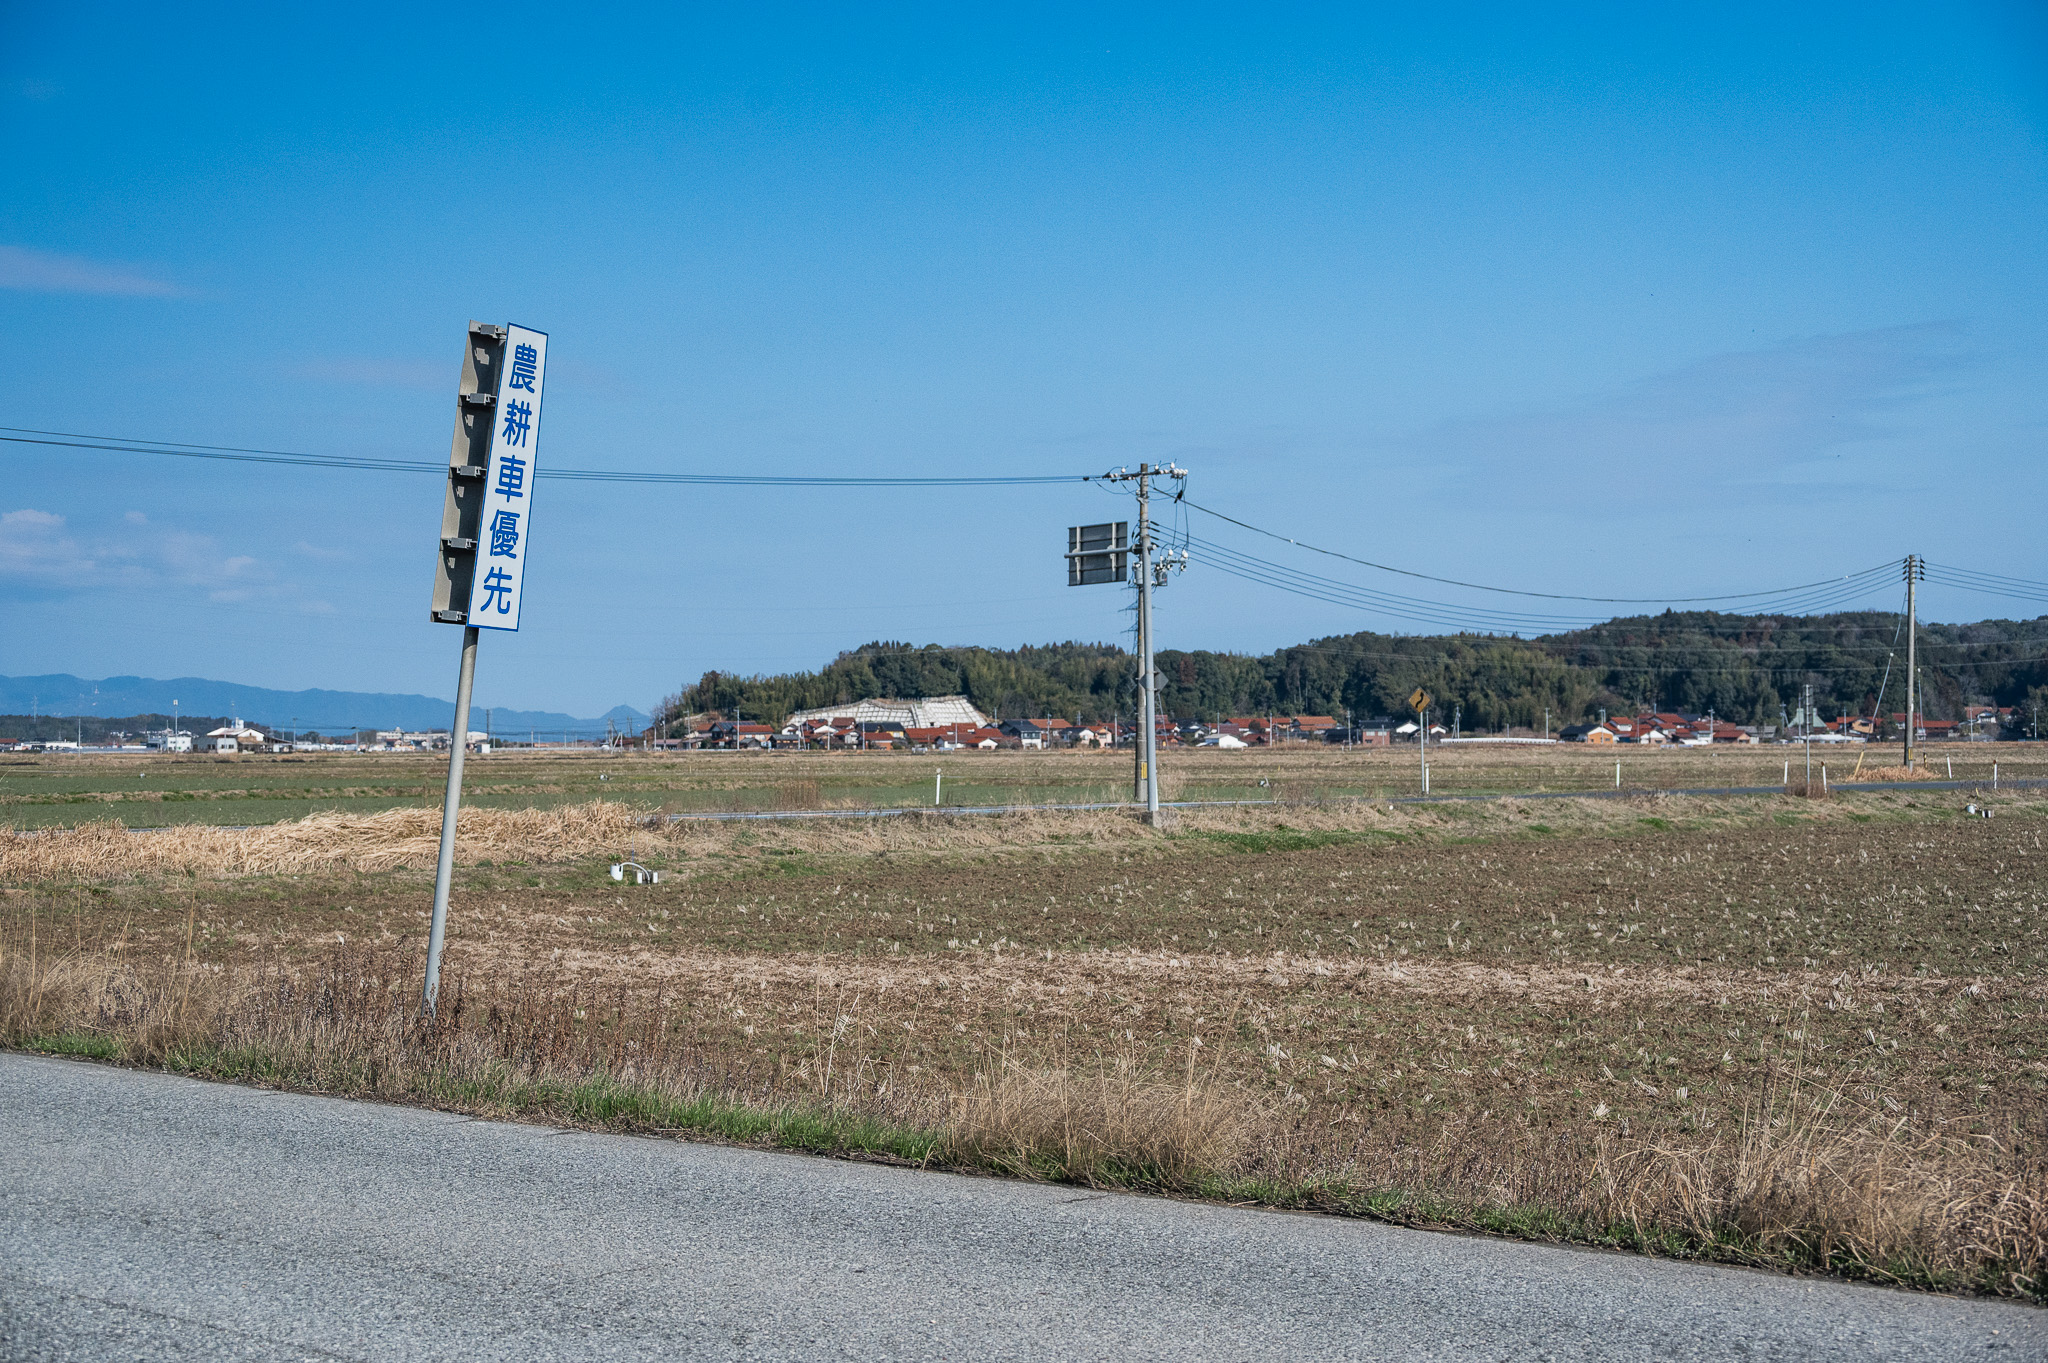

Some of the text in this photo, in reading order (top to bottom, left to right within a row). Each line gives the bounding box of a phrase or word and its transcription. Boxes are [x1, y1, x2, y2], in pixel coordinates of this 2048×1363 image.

[480, 343, 537, 615] 農耕車優先
